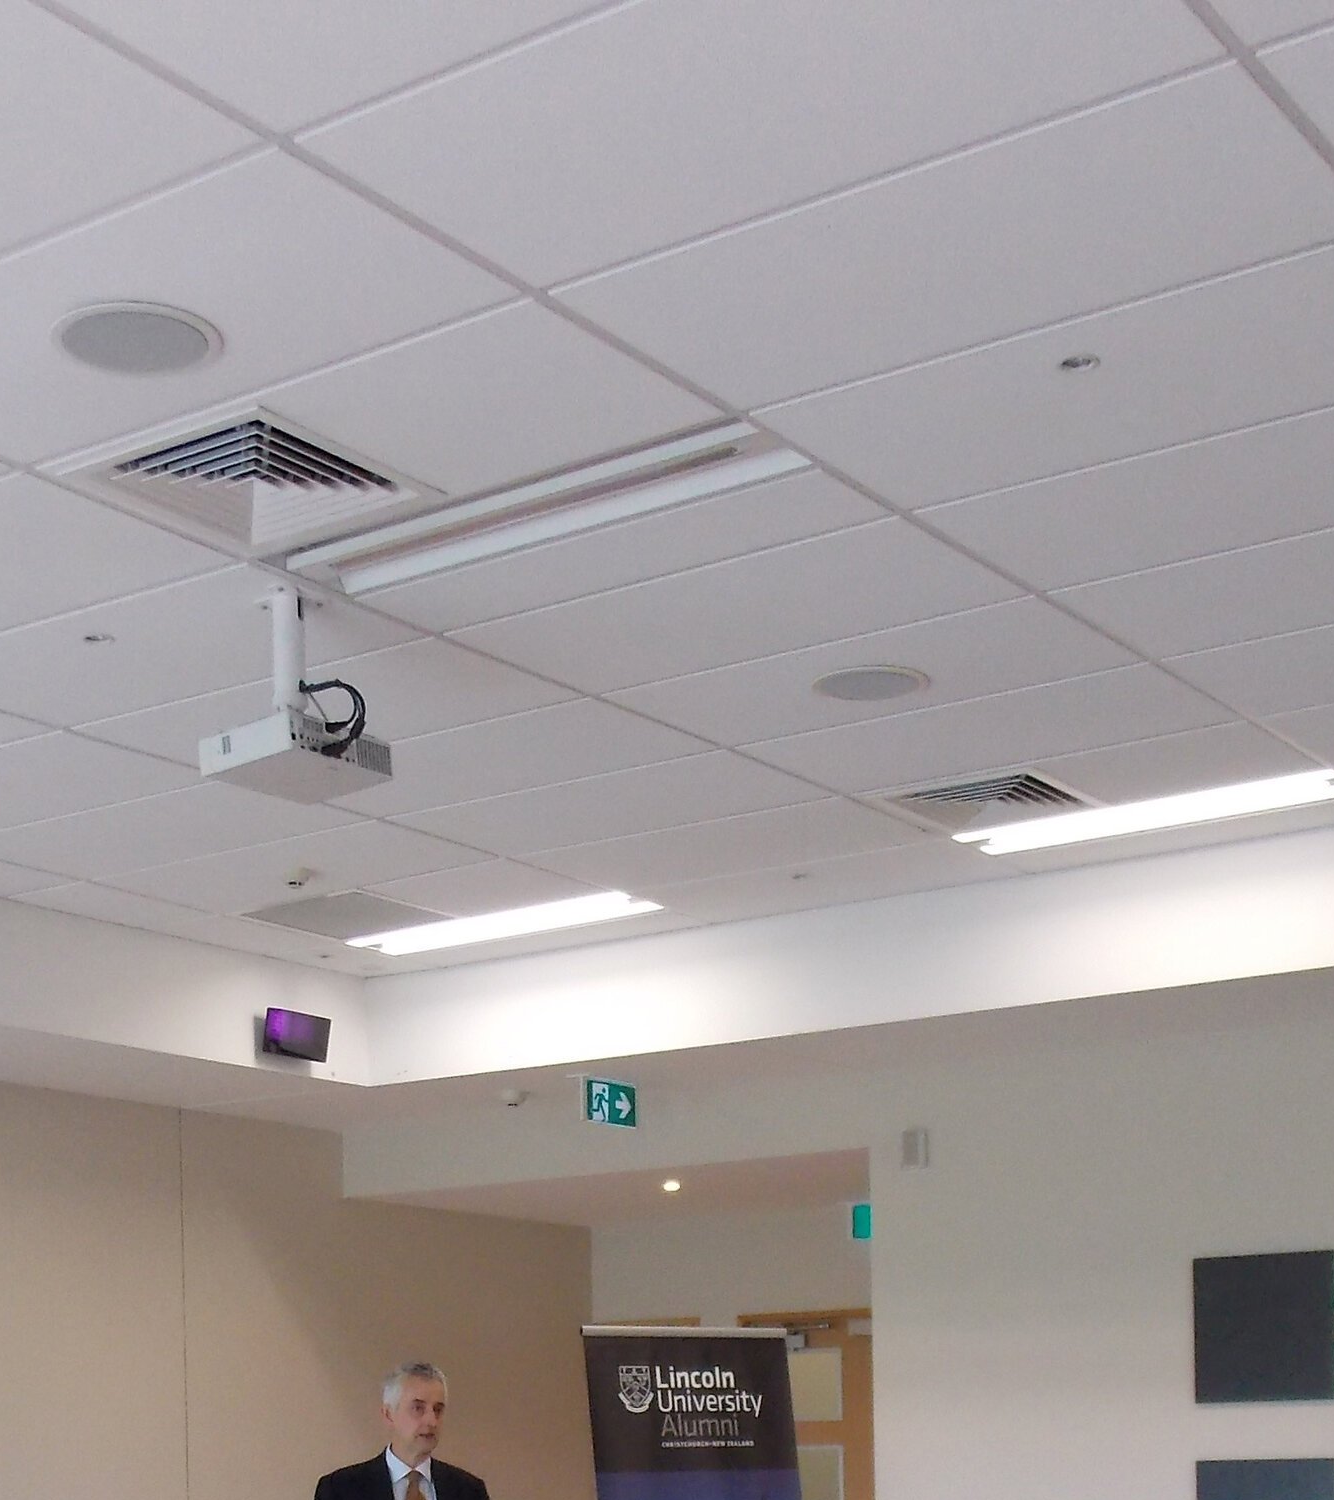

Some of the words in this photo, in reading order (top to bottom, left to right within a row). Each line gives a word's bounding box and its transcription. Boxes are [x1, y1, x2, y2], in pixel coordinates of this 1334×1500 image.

[655, 1365, 735, 1389] Lincoln
[657, 1389, 763, 1418] University
[661, 1413, 739, 1437] Alumni
